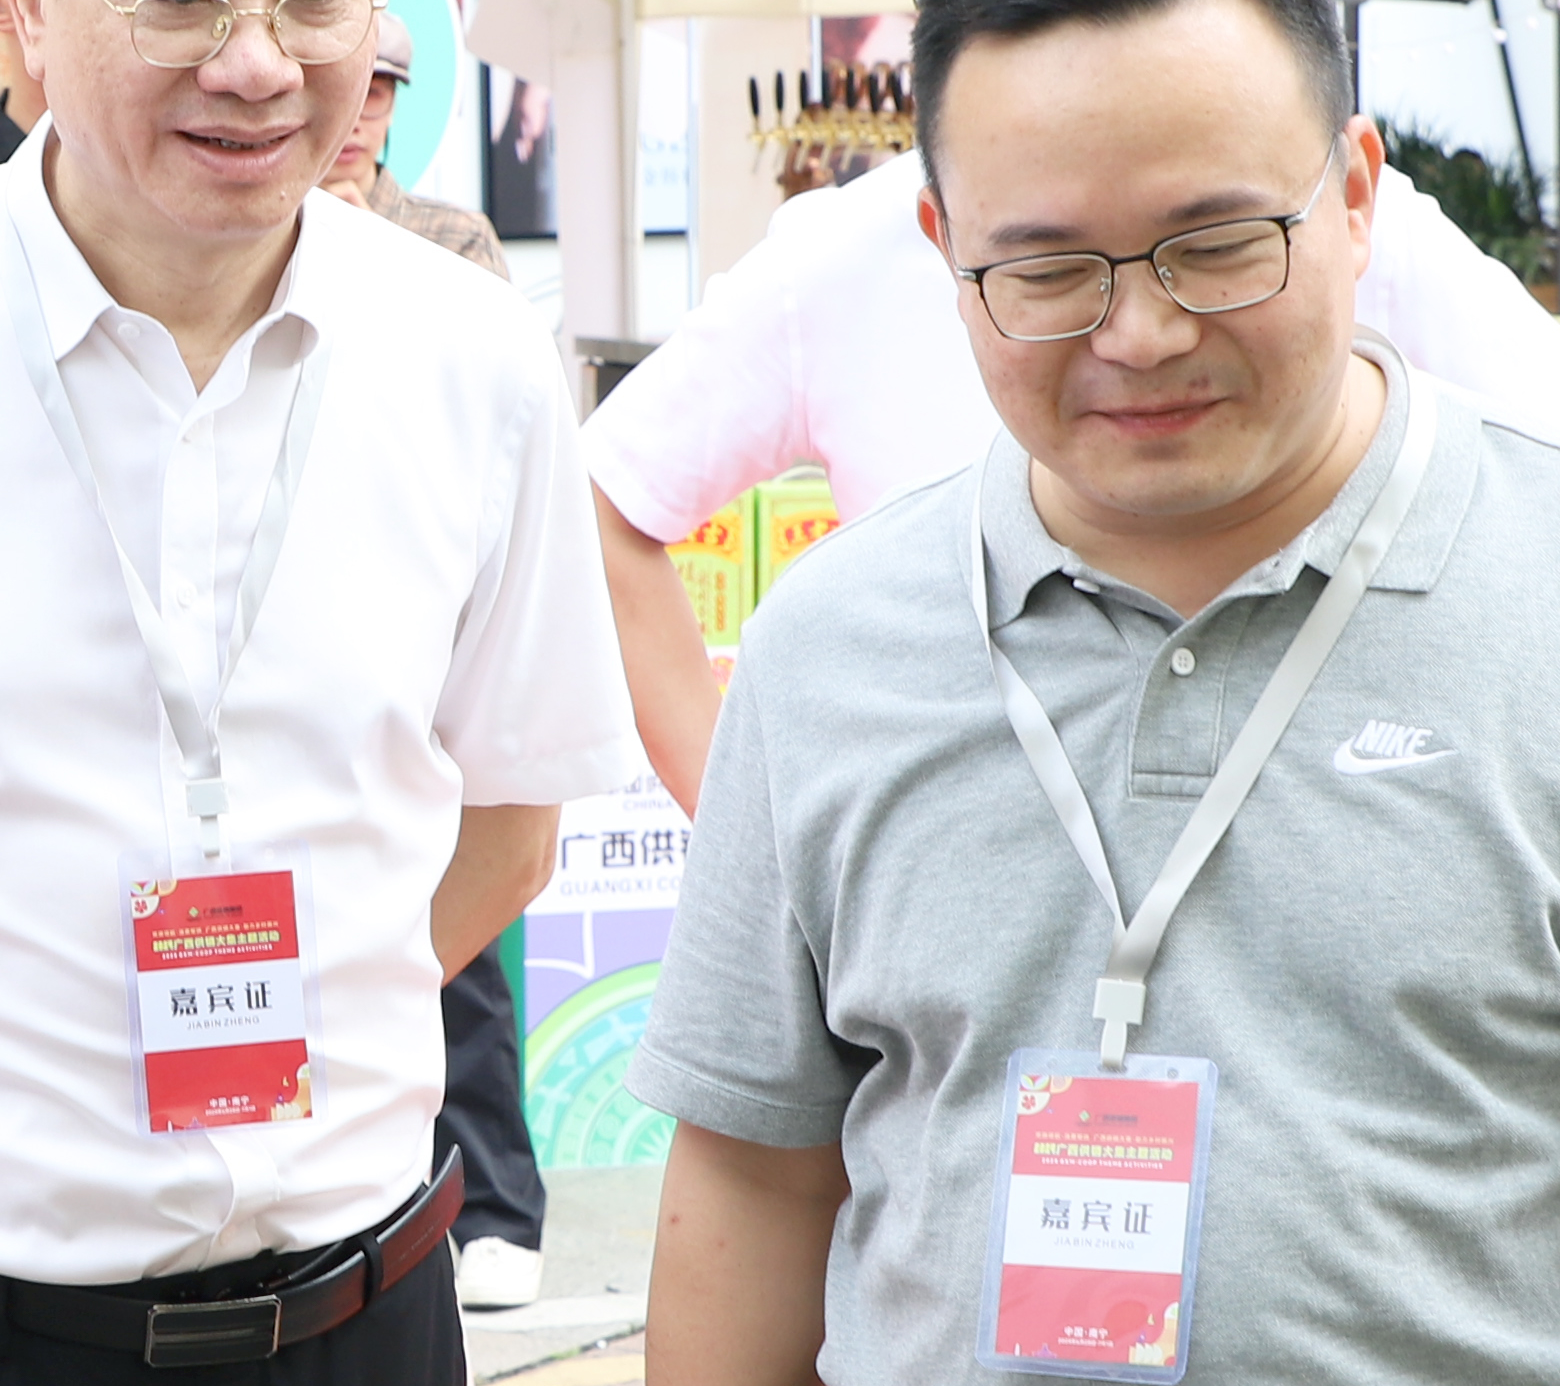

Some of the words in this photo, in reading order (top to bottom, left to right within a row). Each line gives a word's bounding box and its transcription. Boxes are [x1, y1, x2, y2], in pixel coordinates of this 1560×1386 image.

[1354, 719, 1433, 757] NIKE
[559, 875, 652, 898] GUANGXI
[169, 980, 274, 1017] 嘉宾证
[186, 1018, 222, 1031] JIABIN
[224, 1015, 260, 1028] ZHENG
[1040, 1198, 1154, 1235] 嘉宾证
